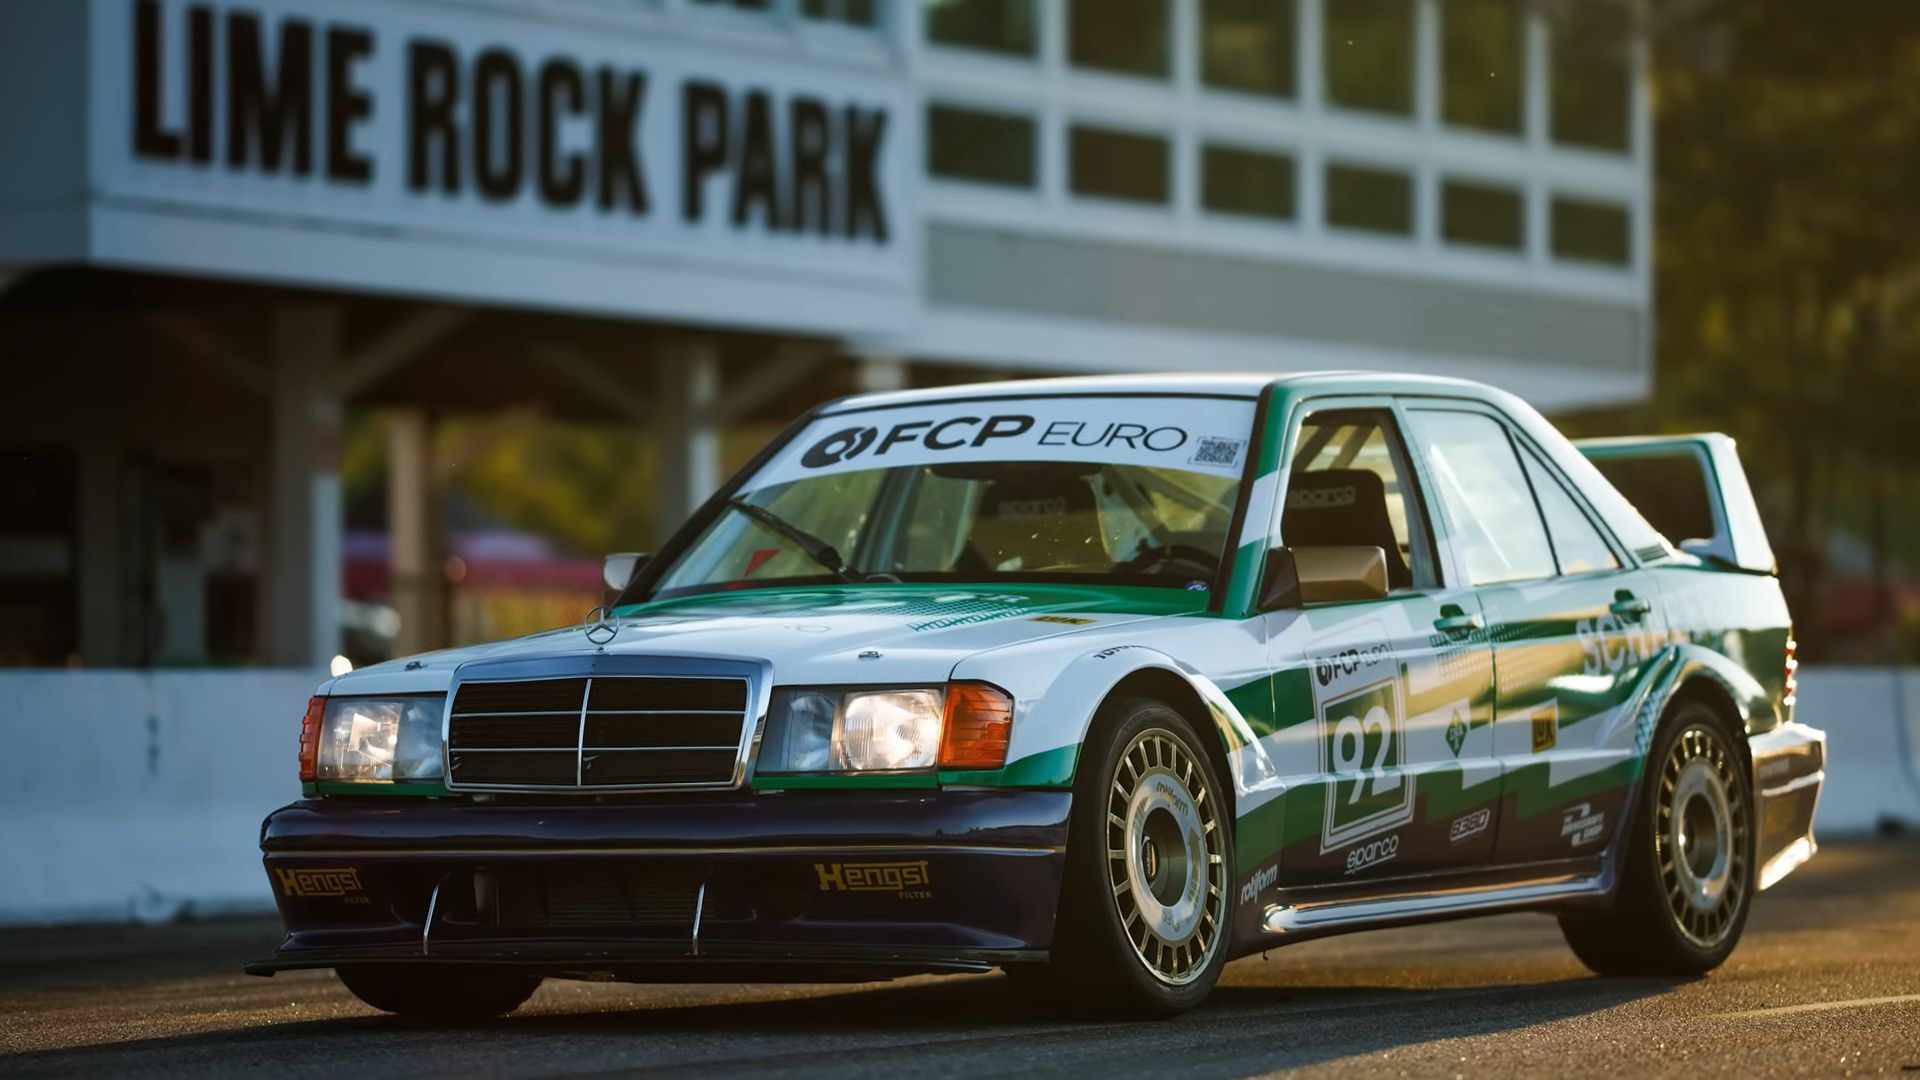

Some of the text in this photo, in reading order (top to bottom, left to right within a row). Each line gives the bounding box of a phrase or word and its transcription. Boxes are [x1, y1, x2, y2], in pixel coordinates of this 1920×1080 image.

[131, 0, 890, 245] LIME ROCK PARK
[875, 414, 1188, 456] FCP EURO
[1333, 705, 1401, 805] 92
[1346, 835, 1399, 874] sparco
[275, 867, 363, 896] Hengst
[814, 860, 929, 891] Hengst
[898, 891, 932, 899] FILTER
[1240, 863, 1278, 905] rotiform
